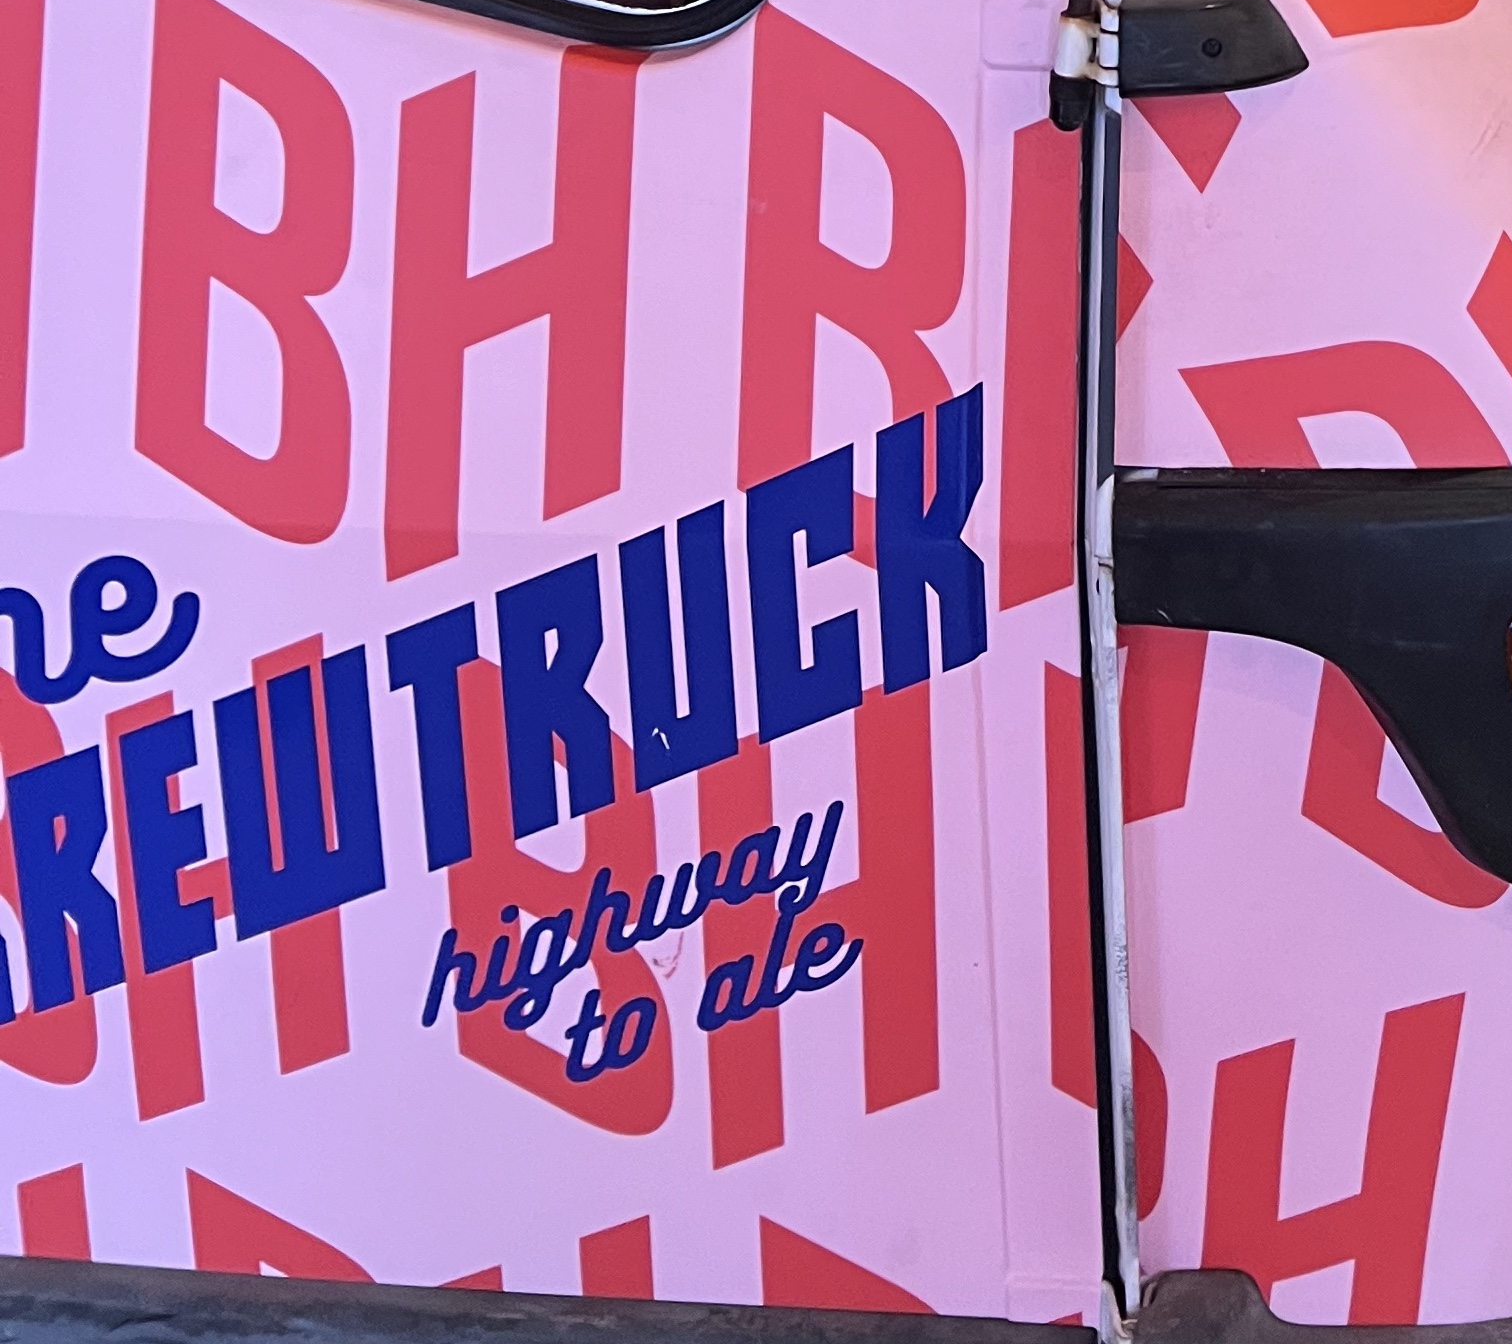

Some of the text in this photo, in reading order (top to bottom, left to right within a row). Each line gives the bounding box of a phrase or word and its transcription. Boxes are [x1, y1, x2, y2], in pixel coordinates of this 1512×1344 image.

[0, 382, 988, 1026] REWTRUCK
[421, 800, 844, 1031] highway
[565, 897, 864, 1082] to ale
